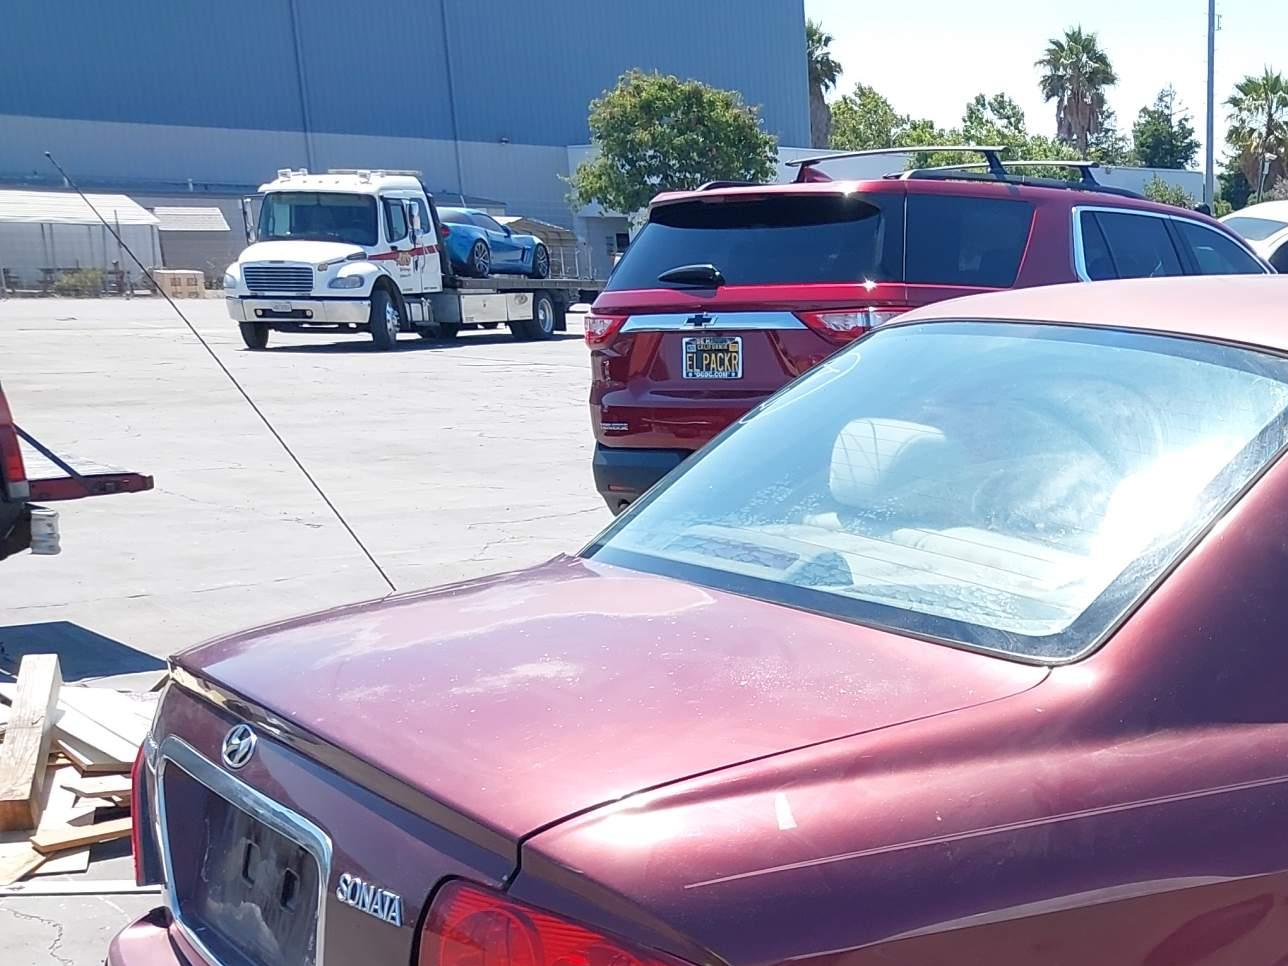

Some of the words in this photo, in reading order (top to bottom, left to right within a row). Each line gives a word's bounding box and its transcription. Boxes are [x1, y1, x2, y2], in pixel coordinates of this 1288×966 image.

[686, 352, 700, 372] EL
[703, 352, 739, 372] PACKR
[336, 873, 402, 928] SONATA
